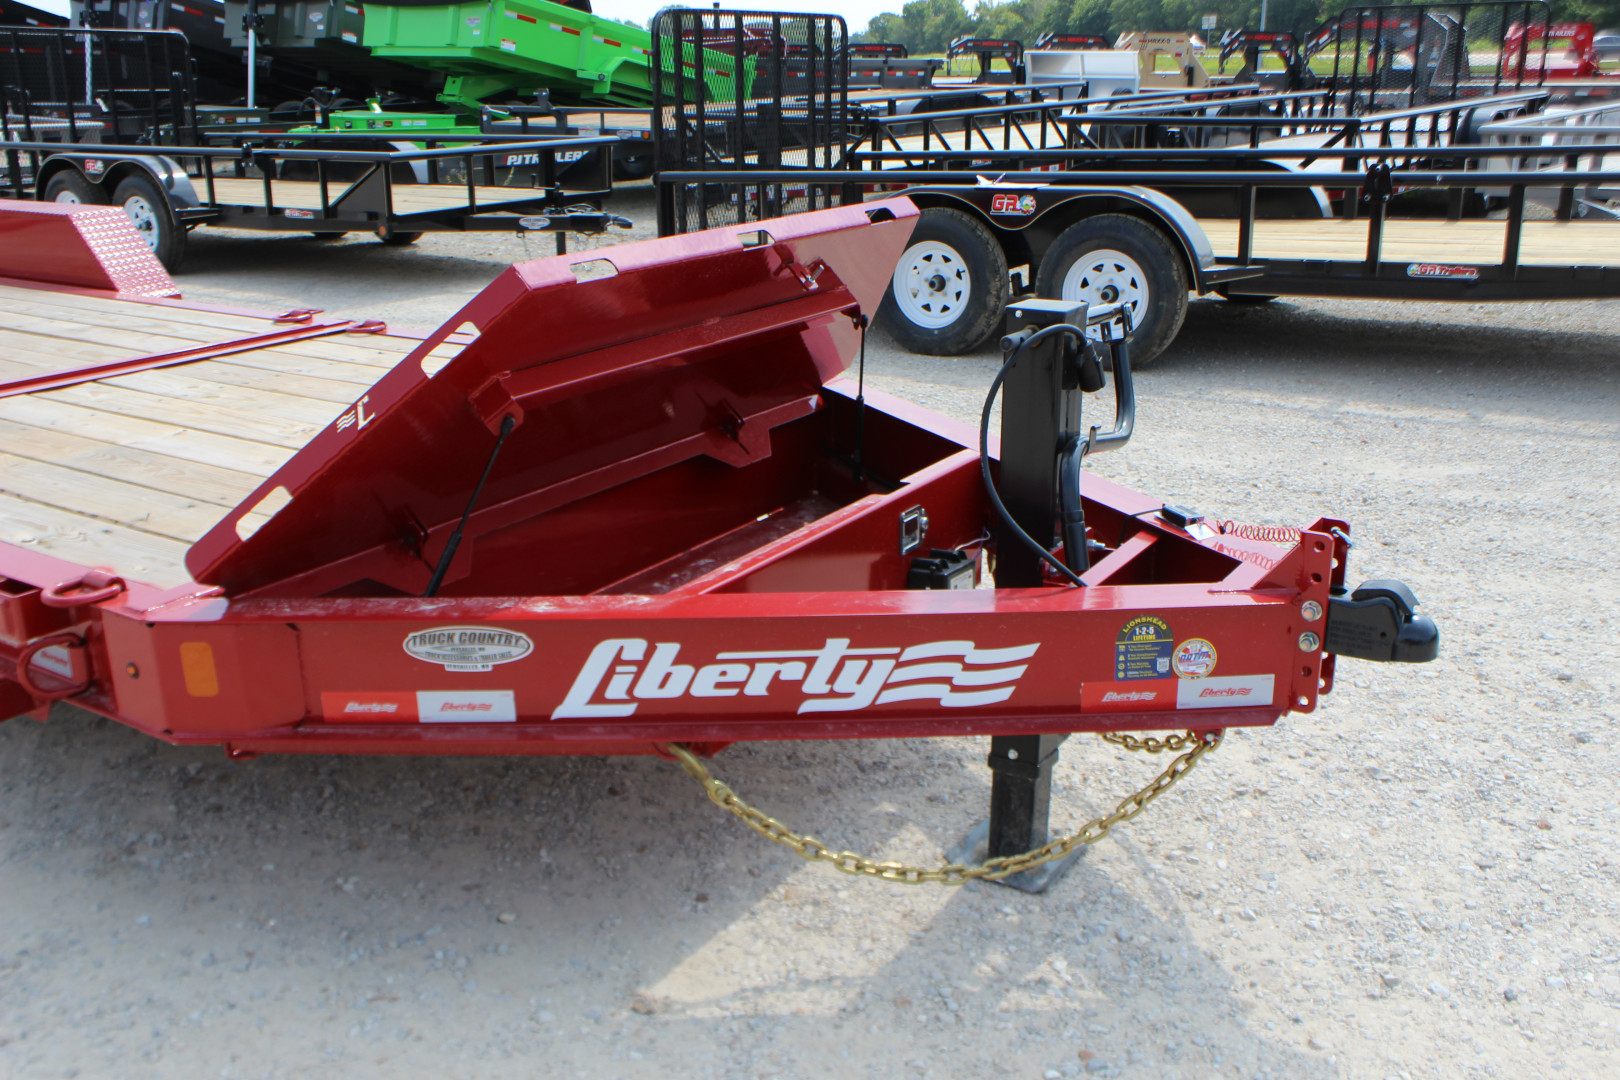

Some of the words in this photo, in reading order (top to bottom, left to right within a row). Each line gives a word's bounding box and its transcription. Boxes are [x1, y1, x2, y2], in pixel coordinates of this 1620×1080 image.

[507, 154, 522, 166] PJ
[1122, 616, 1168, 633] LIONSHEAD
[411, 632, 456, 647] TRUCK
[458, 632, 522, 647] COUNTRY
[551, 638, 901, 721] Liberty
[1101, 691, 1143, 703] Liberty
[1199, 687, 1238, 698] Liberty
[343, 702, 384, 713] Liberty
[439, 702, 478, 713] Liberty
